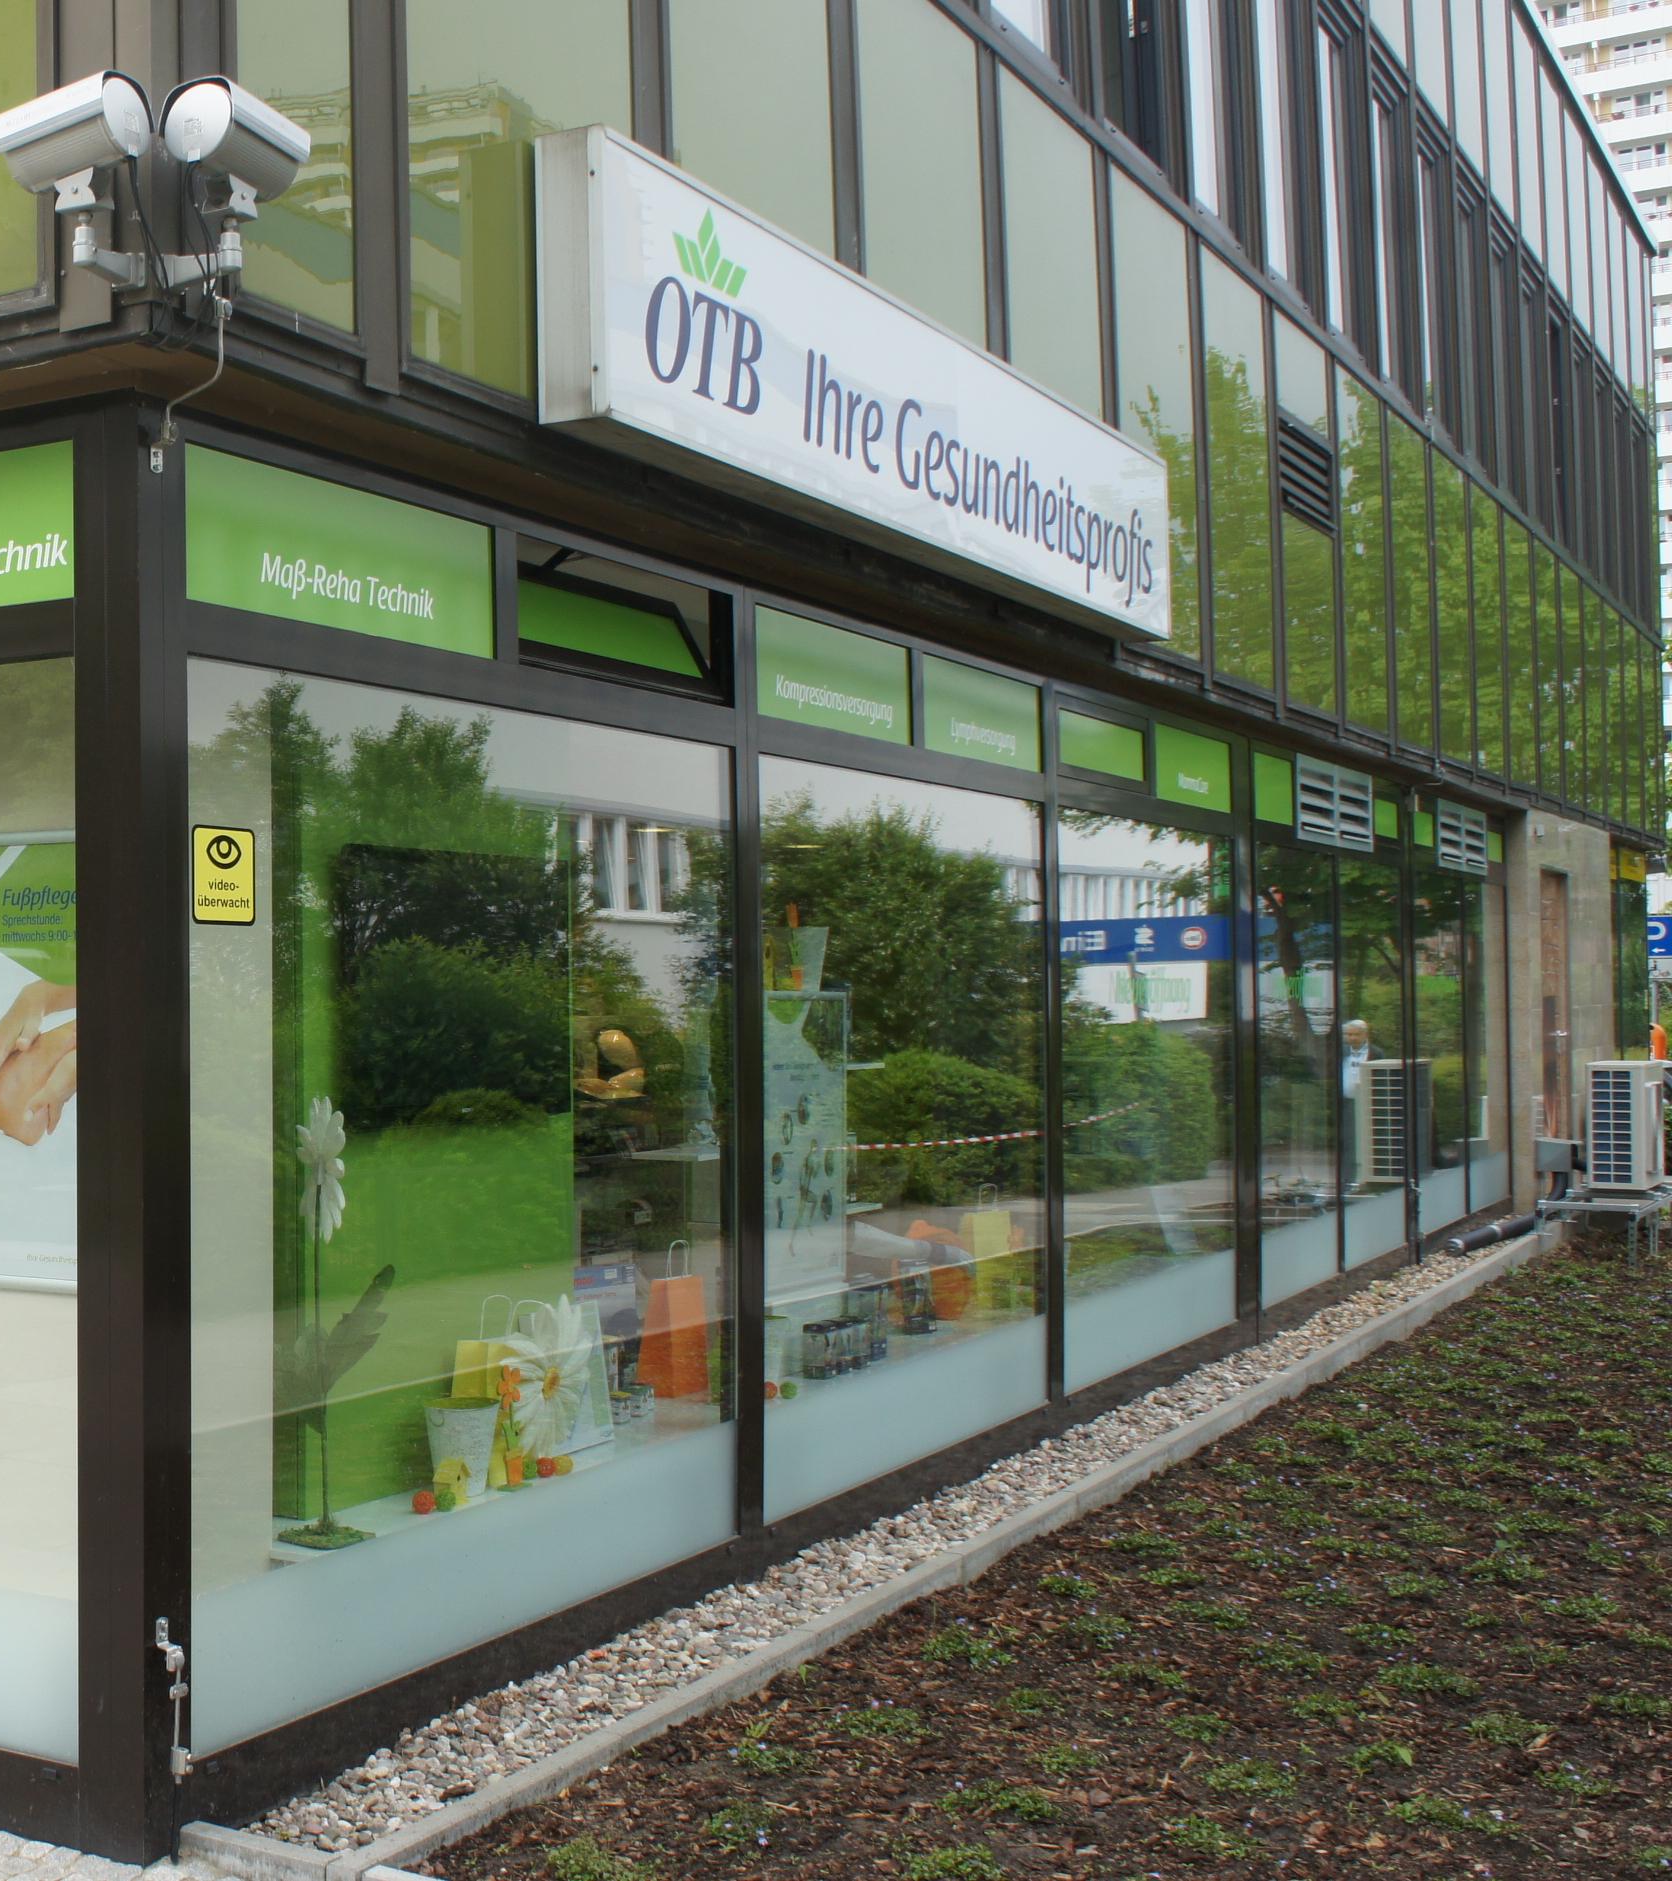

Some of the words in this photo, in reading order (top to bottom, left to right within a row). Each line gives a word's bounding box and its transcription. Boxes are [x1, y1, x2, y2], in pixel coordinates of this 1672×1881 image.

[645, 276, 763, 416] OTB
[802, 348, 884, 474] Ihre
[895, 398, 1153, 608] Gesundheitsprofis
[259, 551, 361, 604] Maß-Reha
[365, 575, 435, 620] Technik
[776, 674, 893, 728] Kompressionsversorgung
[2, 885, 79, 911] Fußpflege
[197, 895, 250, 909] überwacht
[208, 878, 239, 891] video-
